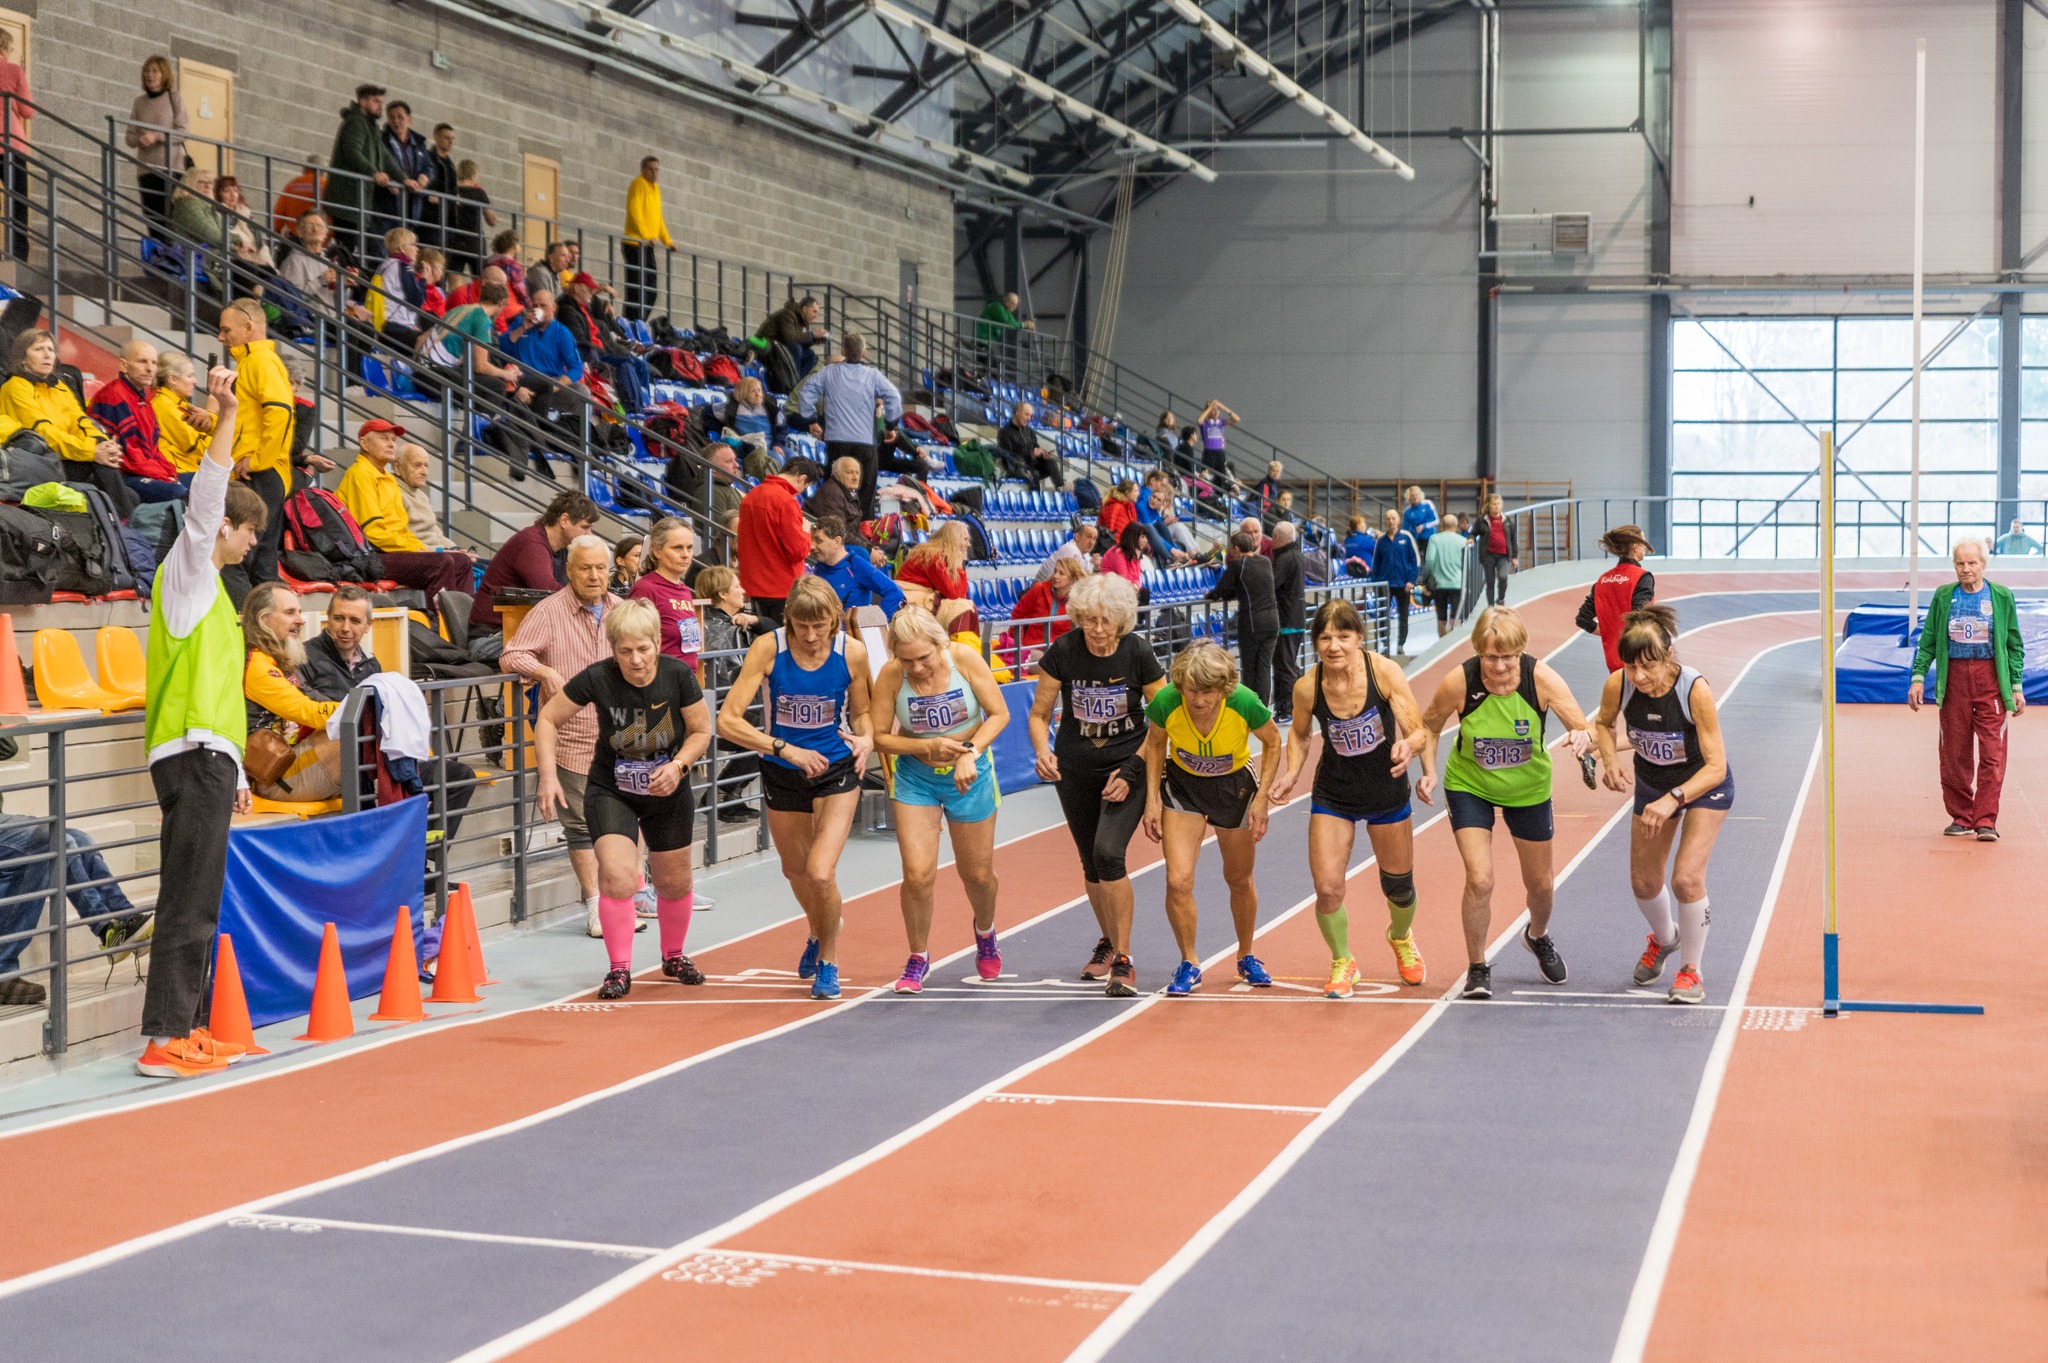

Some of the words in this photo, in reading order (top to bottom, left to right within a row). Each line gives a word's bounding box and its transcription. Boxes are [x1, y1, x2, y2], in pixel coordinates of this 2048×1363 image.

[1964, 623, 1974, 640] 8
[609, 706, 645, 728] WE
[789, 702, 823, 725] 191
[926, 704, 952, 728] 60
[1082, 697, 1117, 719] 145
[1340, 724, 1376, 751] 173
[1484, 746, 1522, 766] 313
[1639, 739, 1674, 761] 146
[1192, 758, 1218, 774] 72
